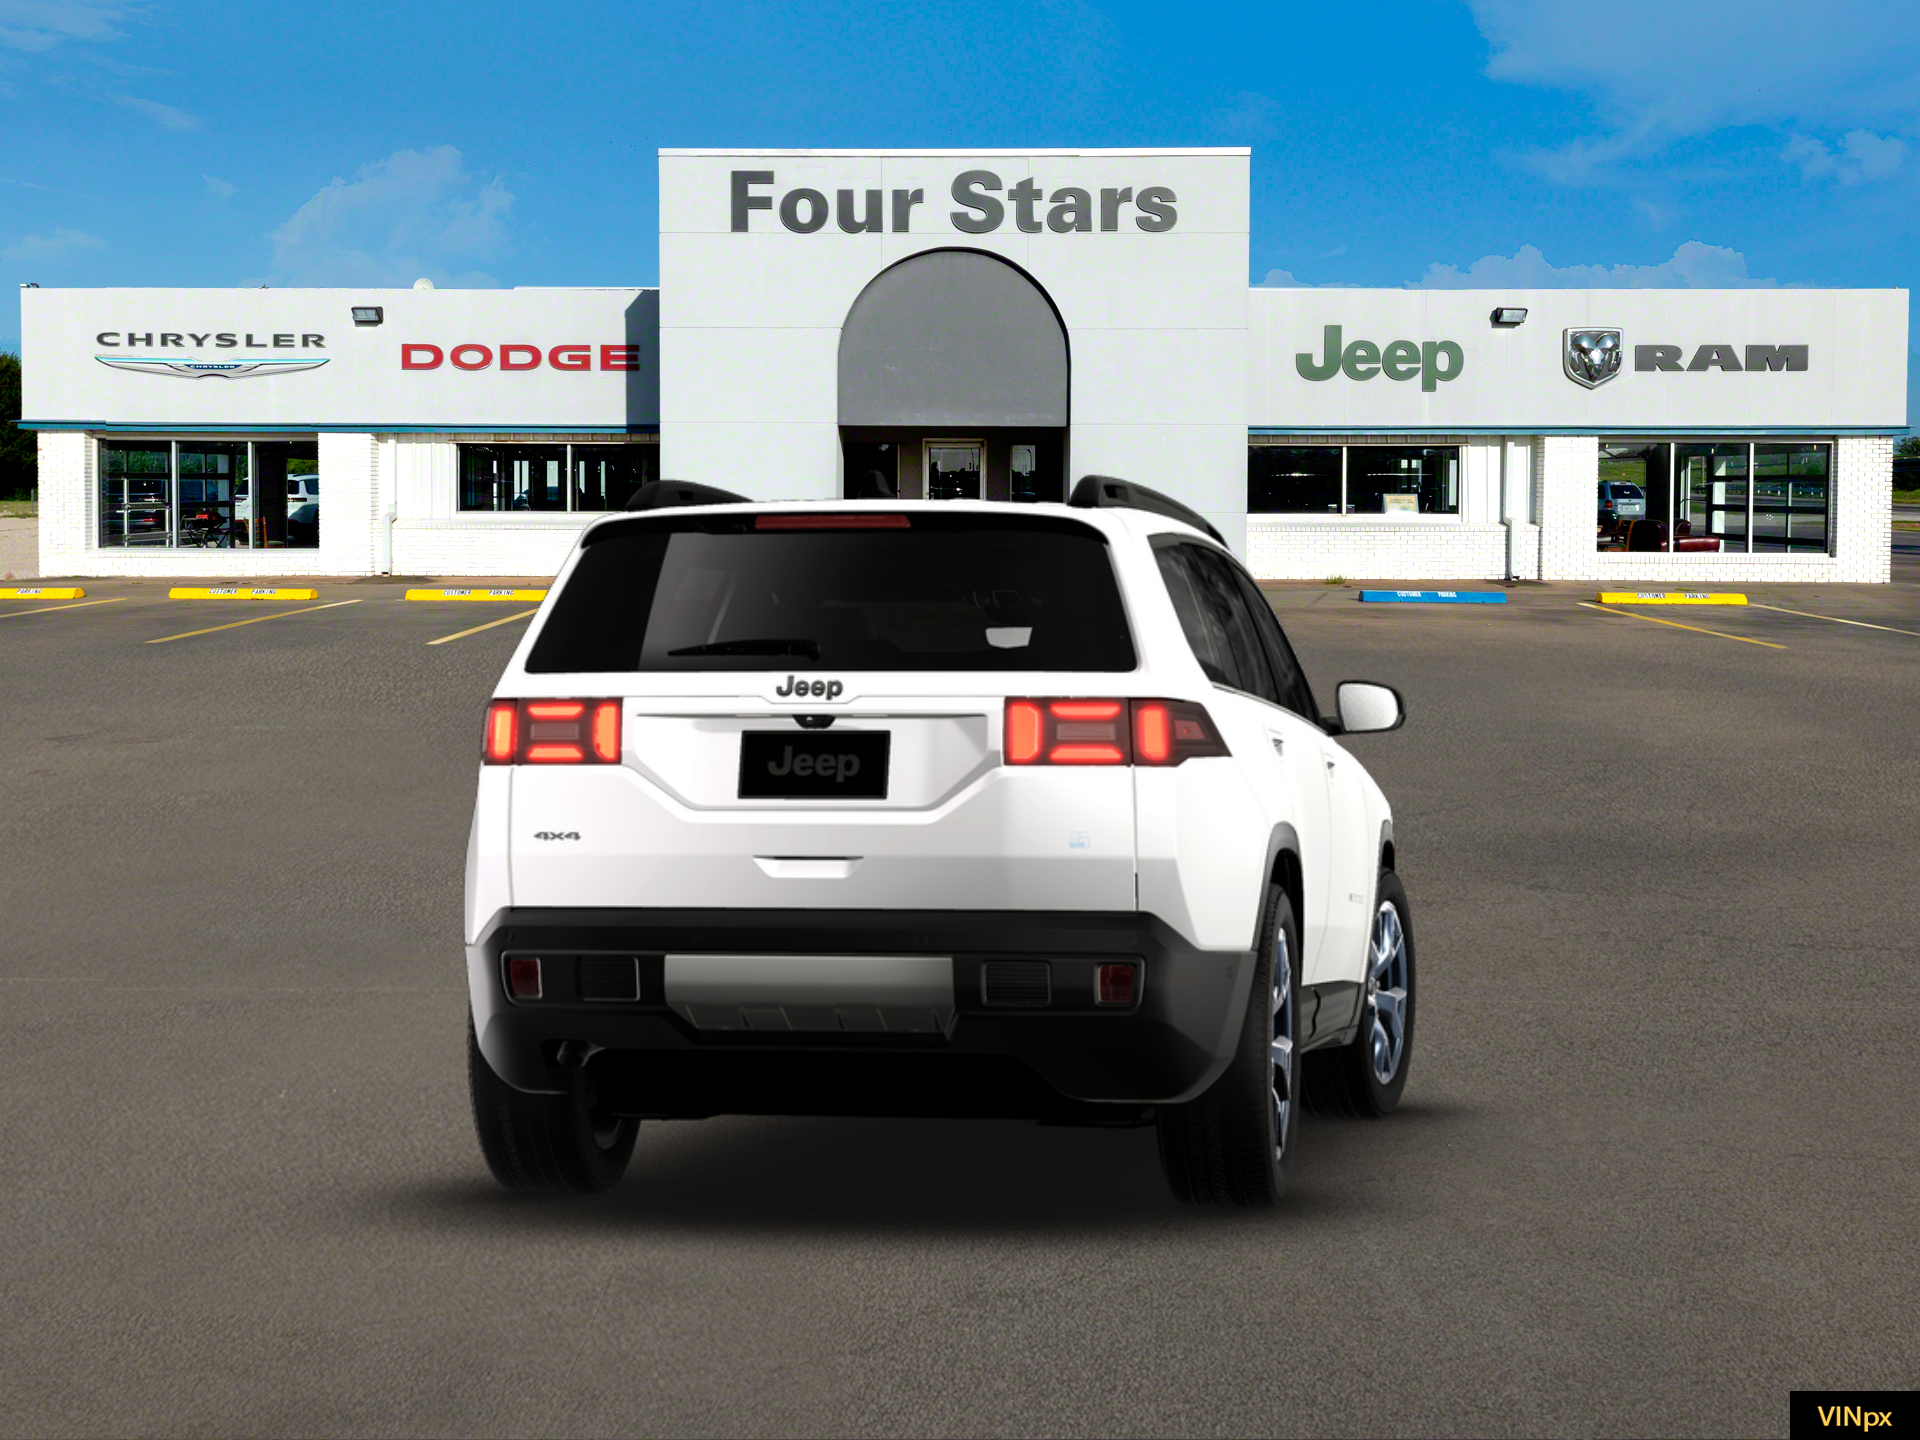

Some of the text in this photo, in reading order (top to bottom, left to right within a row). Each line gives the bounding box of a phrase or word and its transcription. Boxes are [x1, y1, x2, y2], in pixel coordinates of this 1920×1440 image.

[730, 169, 1178, 235] Four Stars
[96, 331, 327, 349] CHRYSLER
[401, 343, 641, 372] DODGE
[1295, 324, 1465, 393] Jeep
[1634, 344, 1809, 372] RAM
[776, 675, 843, 700] Jeep
[767, 745, 861, 783] Jeep
